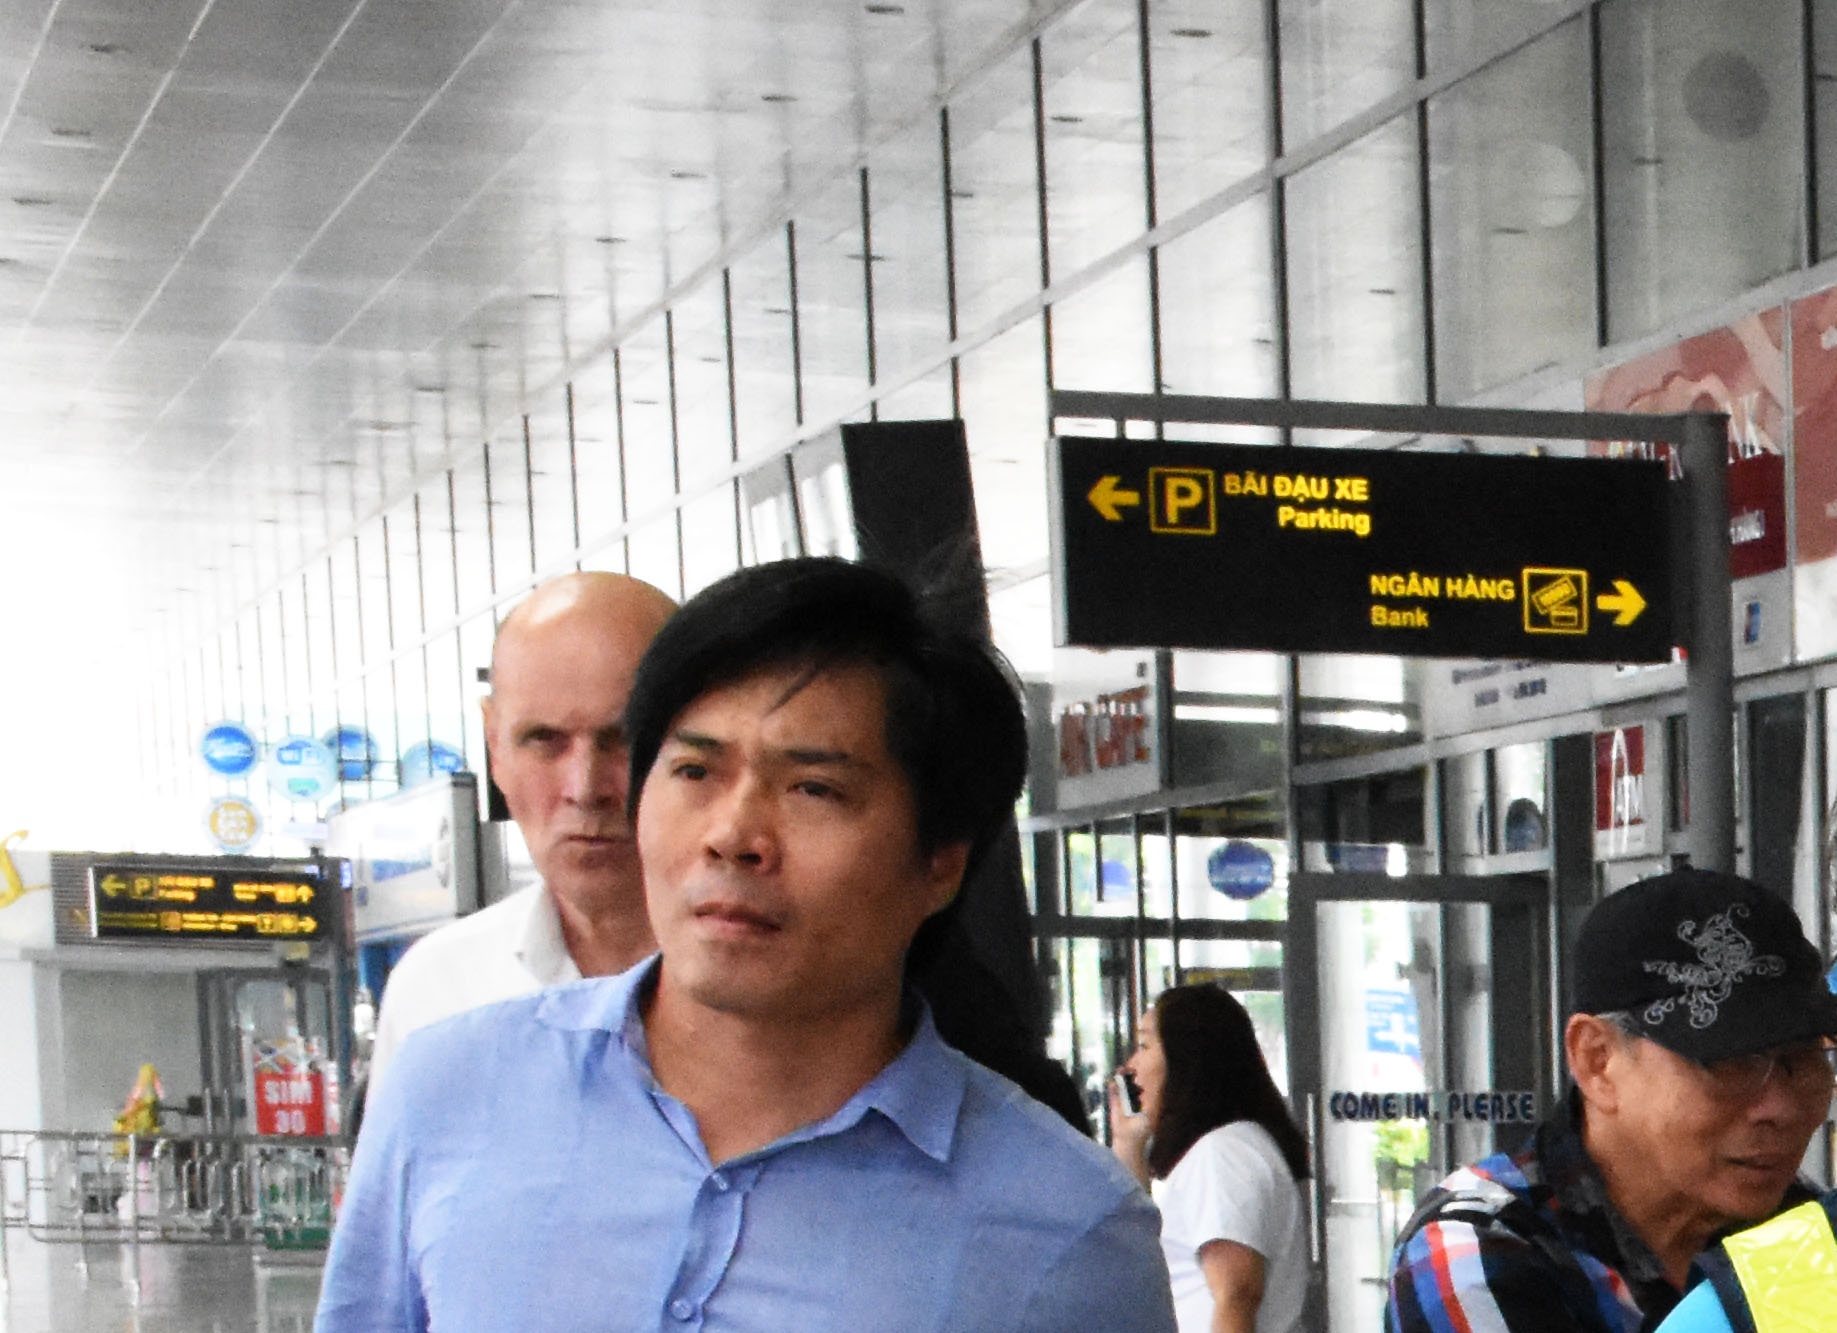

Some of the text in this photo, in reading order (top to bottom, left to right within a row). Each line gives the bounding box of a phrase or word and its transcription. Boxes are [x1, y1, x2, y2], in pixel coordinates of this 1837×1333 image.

[1165, 477, 1202, 524] P
[1334, 478, 1369, 501] XE
[1278, 505, 1371, 537] Parking
[1371, 571, 1515, 600] NGÂN HÀNG
[1371, 604, 1429, 628] Bank
[265, 1080, 313, 1104] SIM
[1330, 1091, 1398, 1119] COME
[1450, 1092, 1534, 1121] PLEASE
